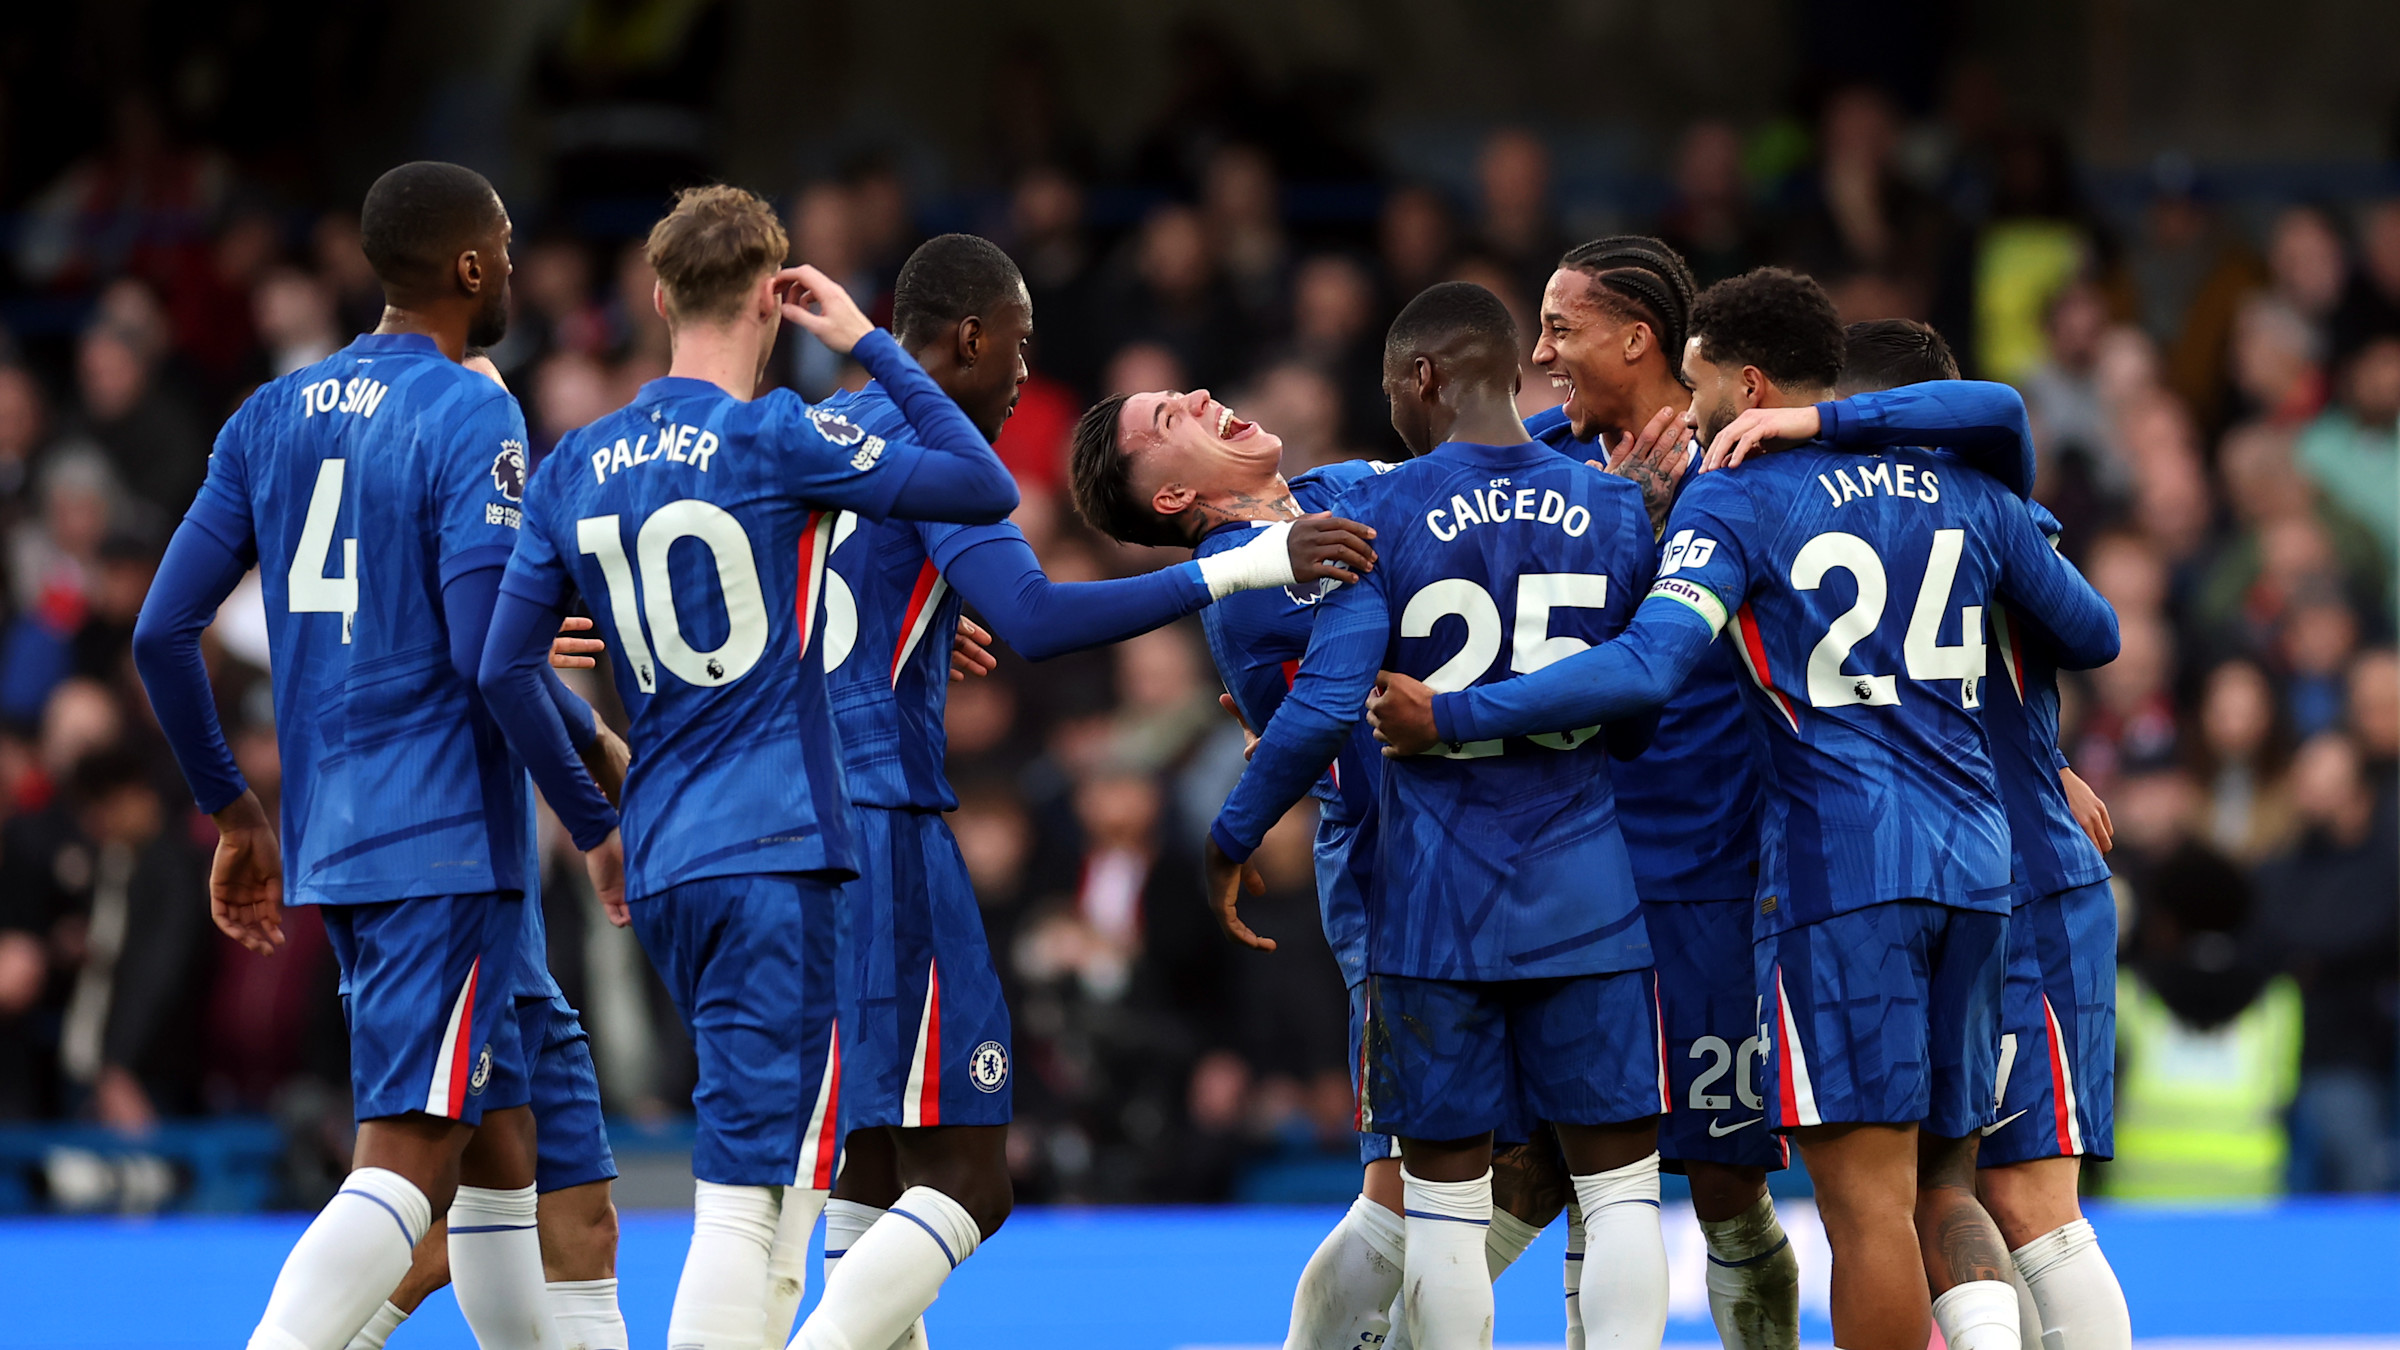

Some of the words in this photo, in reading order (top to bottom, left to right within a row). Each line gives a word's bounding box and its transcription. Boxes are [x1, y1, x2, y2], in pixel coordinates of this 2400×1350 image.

[302, 377, 389, 419] TOSIN
[591, 422, 719, 485] PALMER
[486, 503, 504, 516] No
[1490, 478, 1511, 488] CFC
[1818, 463, 1940, 508] JAMES
[1426, 488, 1591, 542] CAICEDO
[288, 458, 359, 645] 4
[576, 499, 769, 694] 10
[1649, 580, 1700, 603] ptain
[1790, 529, 1987, 709] 24
[1401, 573, 1608, 759] 25
[1689, 1036, 1764, 1110] 20
